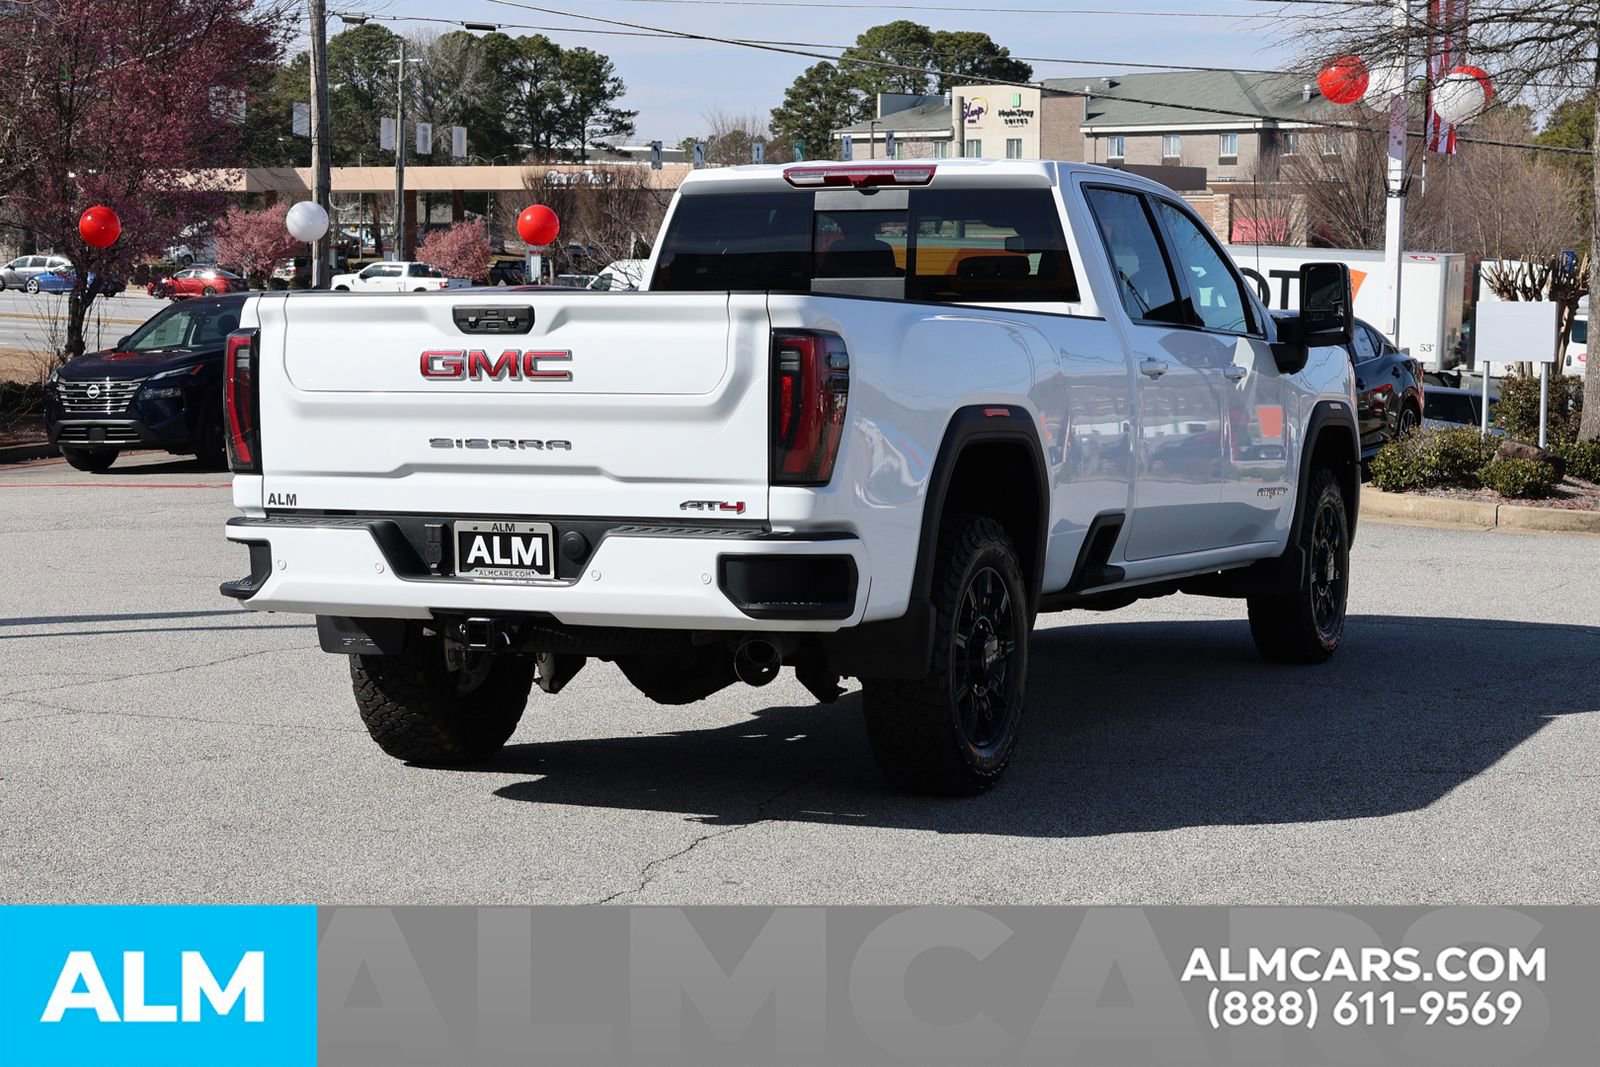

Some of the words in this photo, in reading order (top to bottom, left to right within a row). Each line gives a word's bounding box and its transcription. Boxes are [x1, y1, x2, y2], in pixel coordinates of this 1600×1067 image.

[420, 349, 573, 381] GMC
[429, 438, 572, 450] SIERRA
[268, 493, 297, 506] ALM
[680, 500, 746, 514] AT4
[491, 523, 515, 532] ALM
[467, 535, 543, 566] ALM
